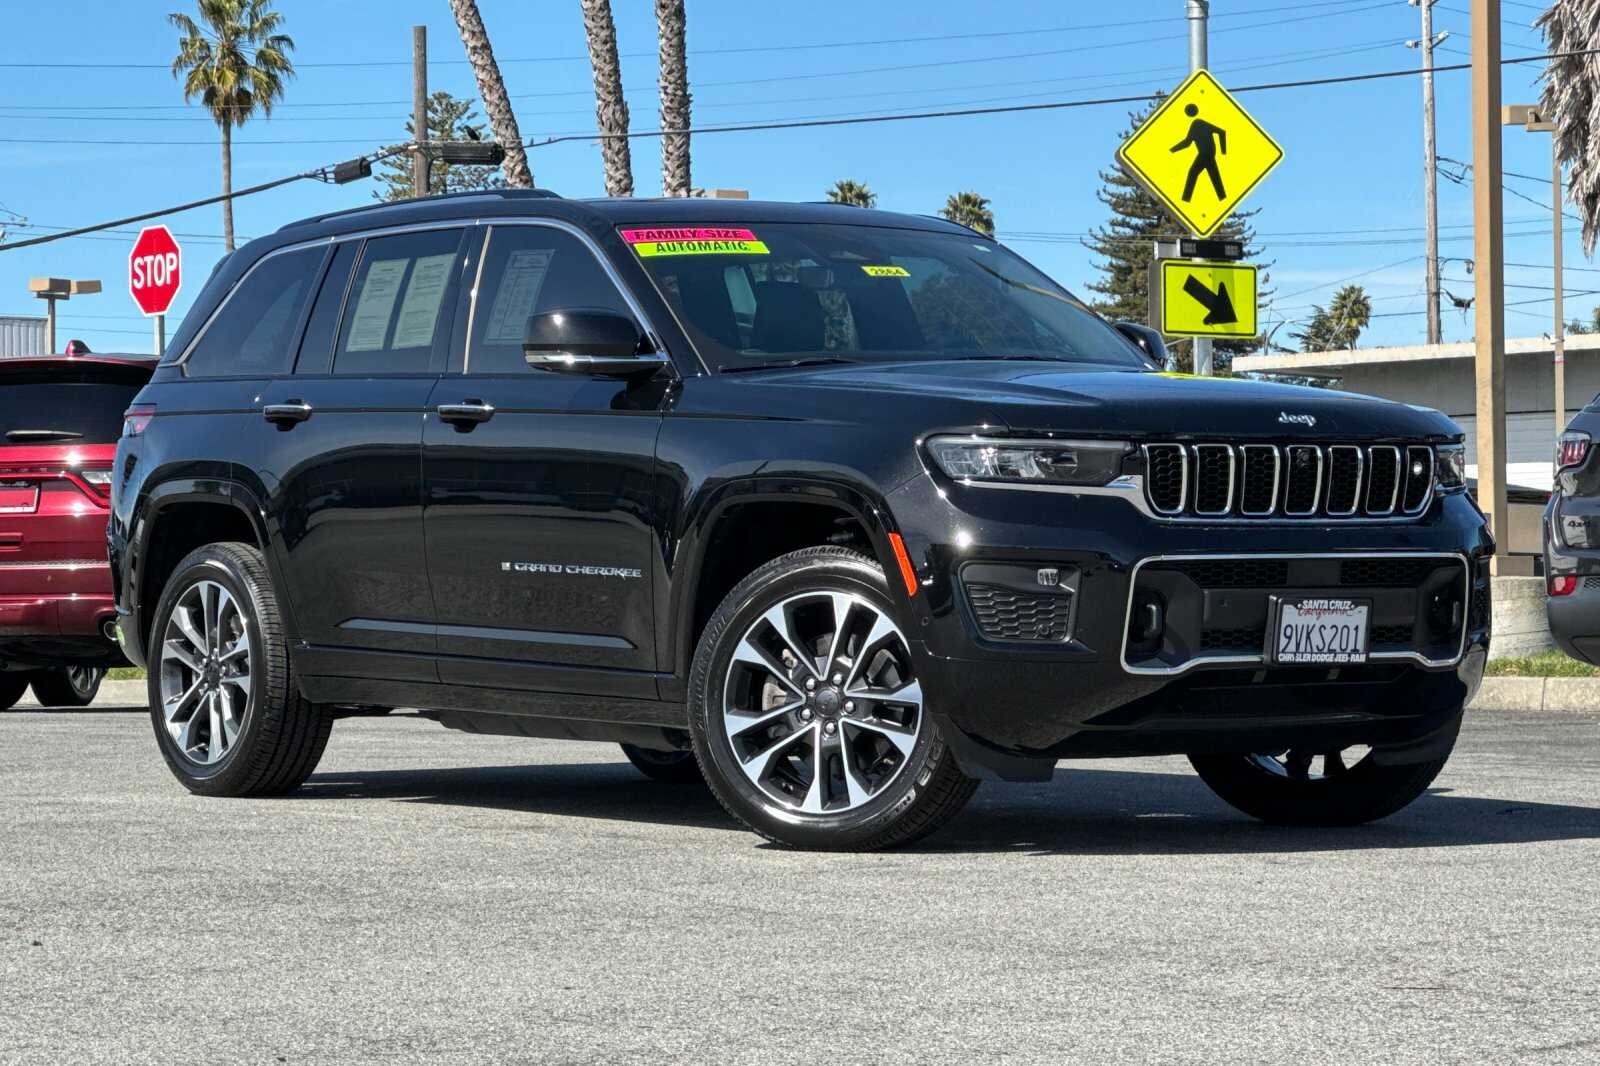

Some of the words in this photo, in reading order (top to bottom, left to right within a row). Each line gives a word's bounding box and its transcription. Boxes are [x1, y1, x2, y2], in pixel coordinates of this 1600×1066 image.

[634, 230, 697, 240] FAMILY
[705, 230, 744, 239] SIZE
[655, 241, 749, 253] AUTOMATIC
[133, 252, 178, 289] STOP
[1278, 411, 1317, 427] Jeep
[514, 562, 562, 573] GRAND
[565, 565, 642, 579] CHEROKEE
[1302, 599, 1328, 609] SANTA
[1330, 600, 1352, 610] CRUZ
[1281, 624, 1360, 653] 9VKS201
